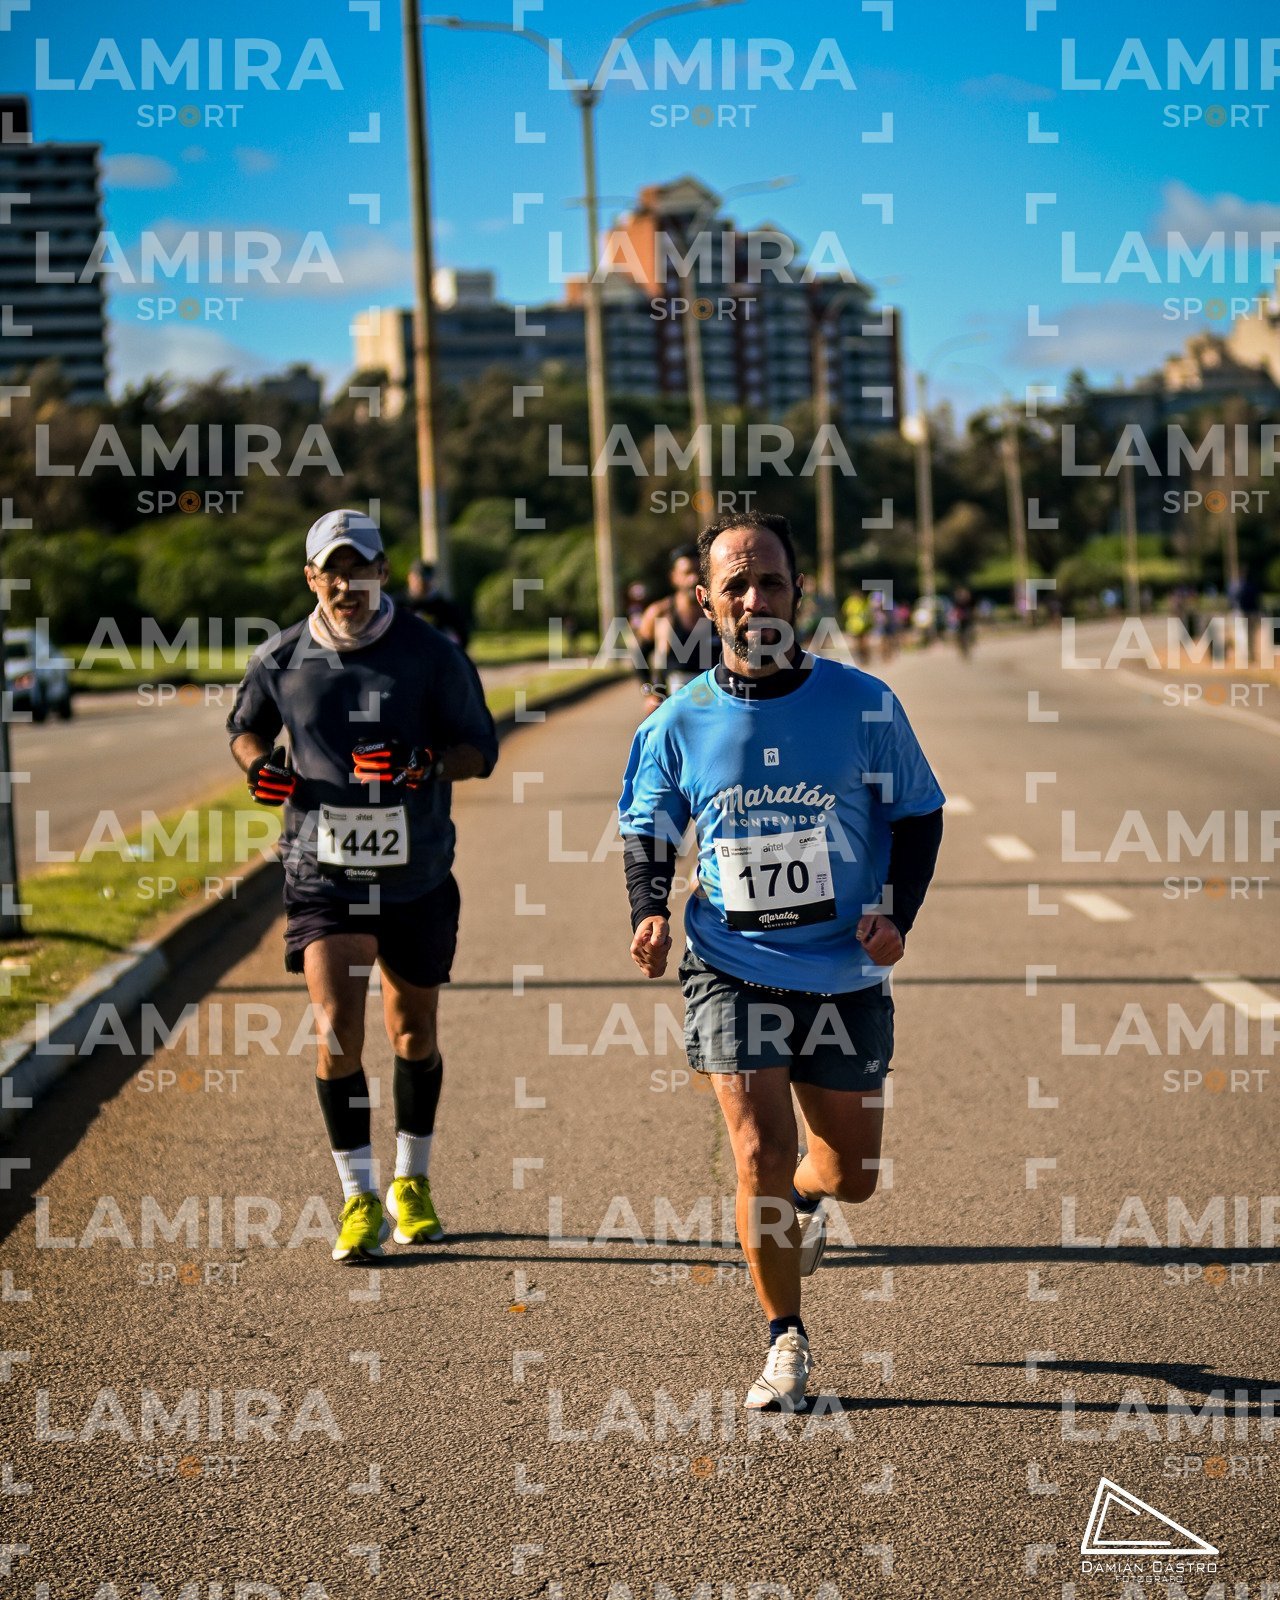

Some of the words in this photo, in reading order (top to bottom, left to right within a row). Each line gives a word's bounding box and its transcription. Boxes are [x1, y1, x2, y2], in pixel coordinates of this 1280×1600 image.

[714, 782, 836, 814] Maratón
[728, 813, 826, 828] MONTEVIDEO
[326, 828, 399, 857] 1442
[762, 842, 784, 853] antel
[738, 860, 810, 899] 170
[758, 911, 800, 924] Maratón
